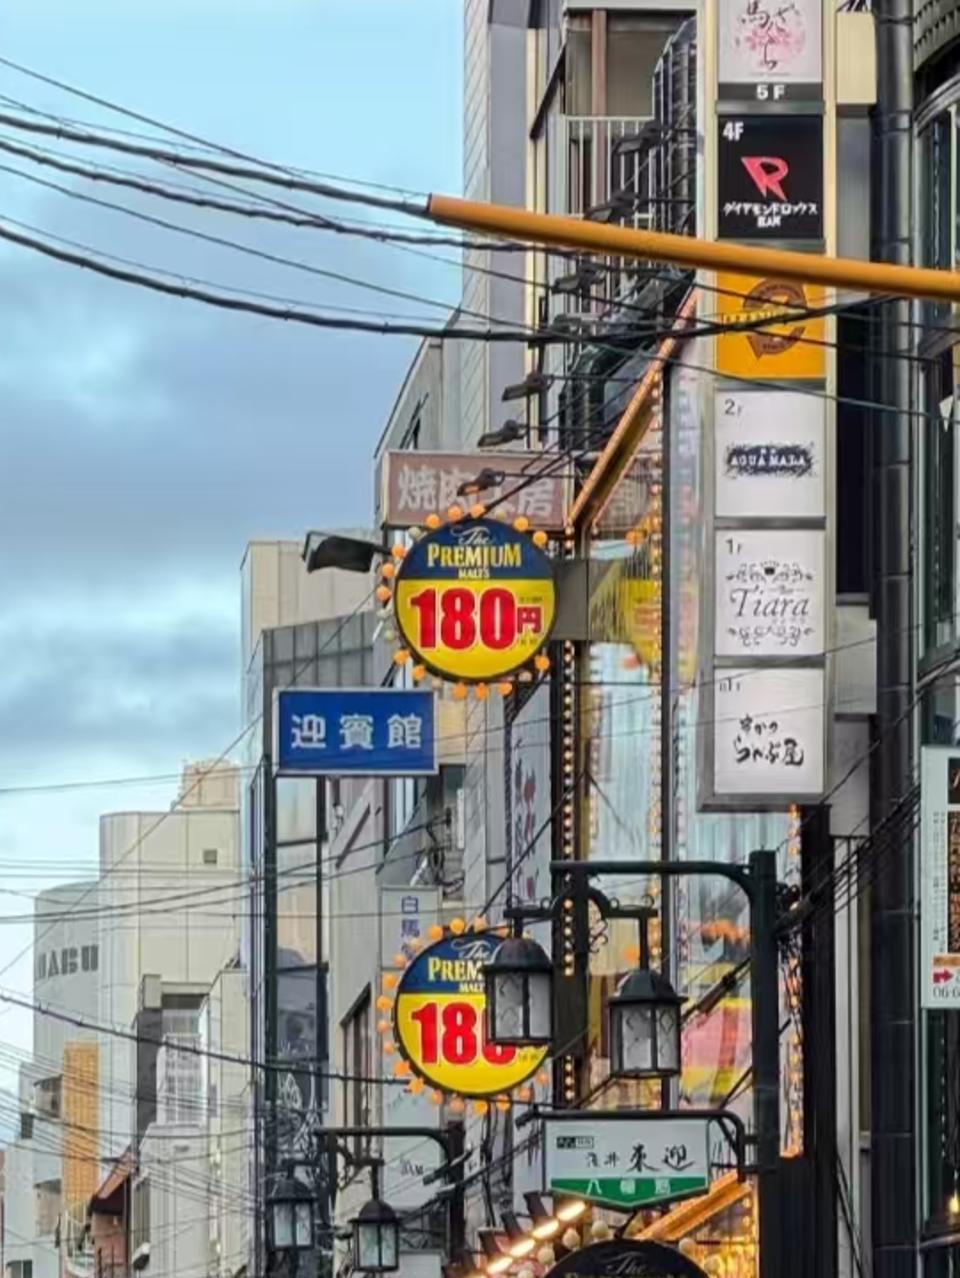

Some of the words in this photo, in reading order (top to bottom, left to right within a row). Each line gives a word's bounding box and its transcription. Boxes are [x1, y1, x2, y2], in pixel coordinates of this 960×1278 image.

[722, 121, 744, 141] 4F
[427, 544, 522, 568] PREMIUM
[730, 585, 810, 618] Tiara
[290, 713, 423, 750] 迎賓館
